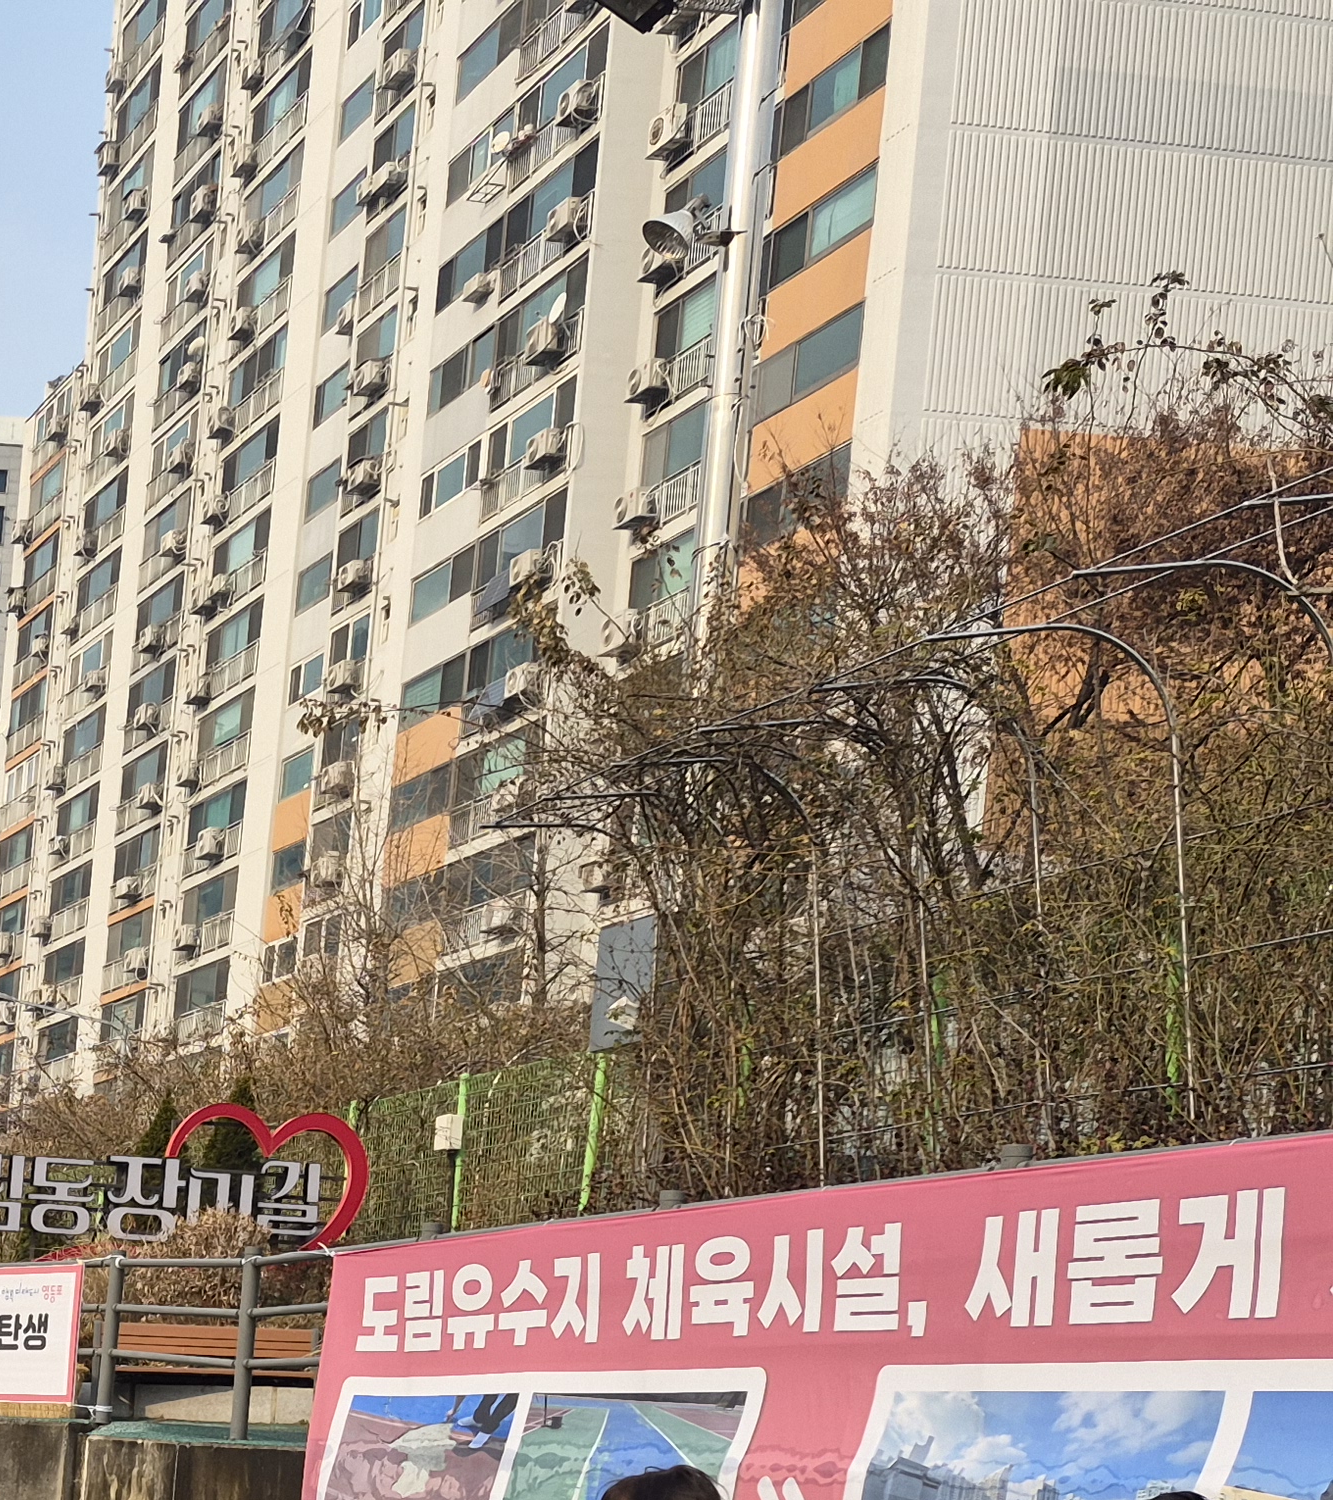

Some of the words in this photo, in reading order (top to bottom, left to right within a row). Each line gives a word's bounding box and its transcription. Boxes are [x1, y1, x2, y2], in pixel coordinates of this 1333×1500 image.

[41, 1284, 64, 1304] 영등포
[355, 1251, 602, 1353] 도림유수지
[622, 1222, 929, 1341] 체육시설,
[964, 1186, 1286, 1328] 새롭게
